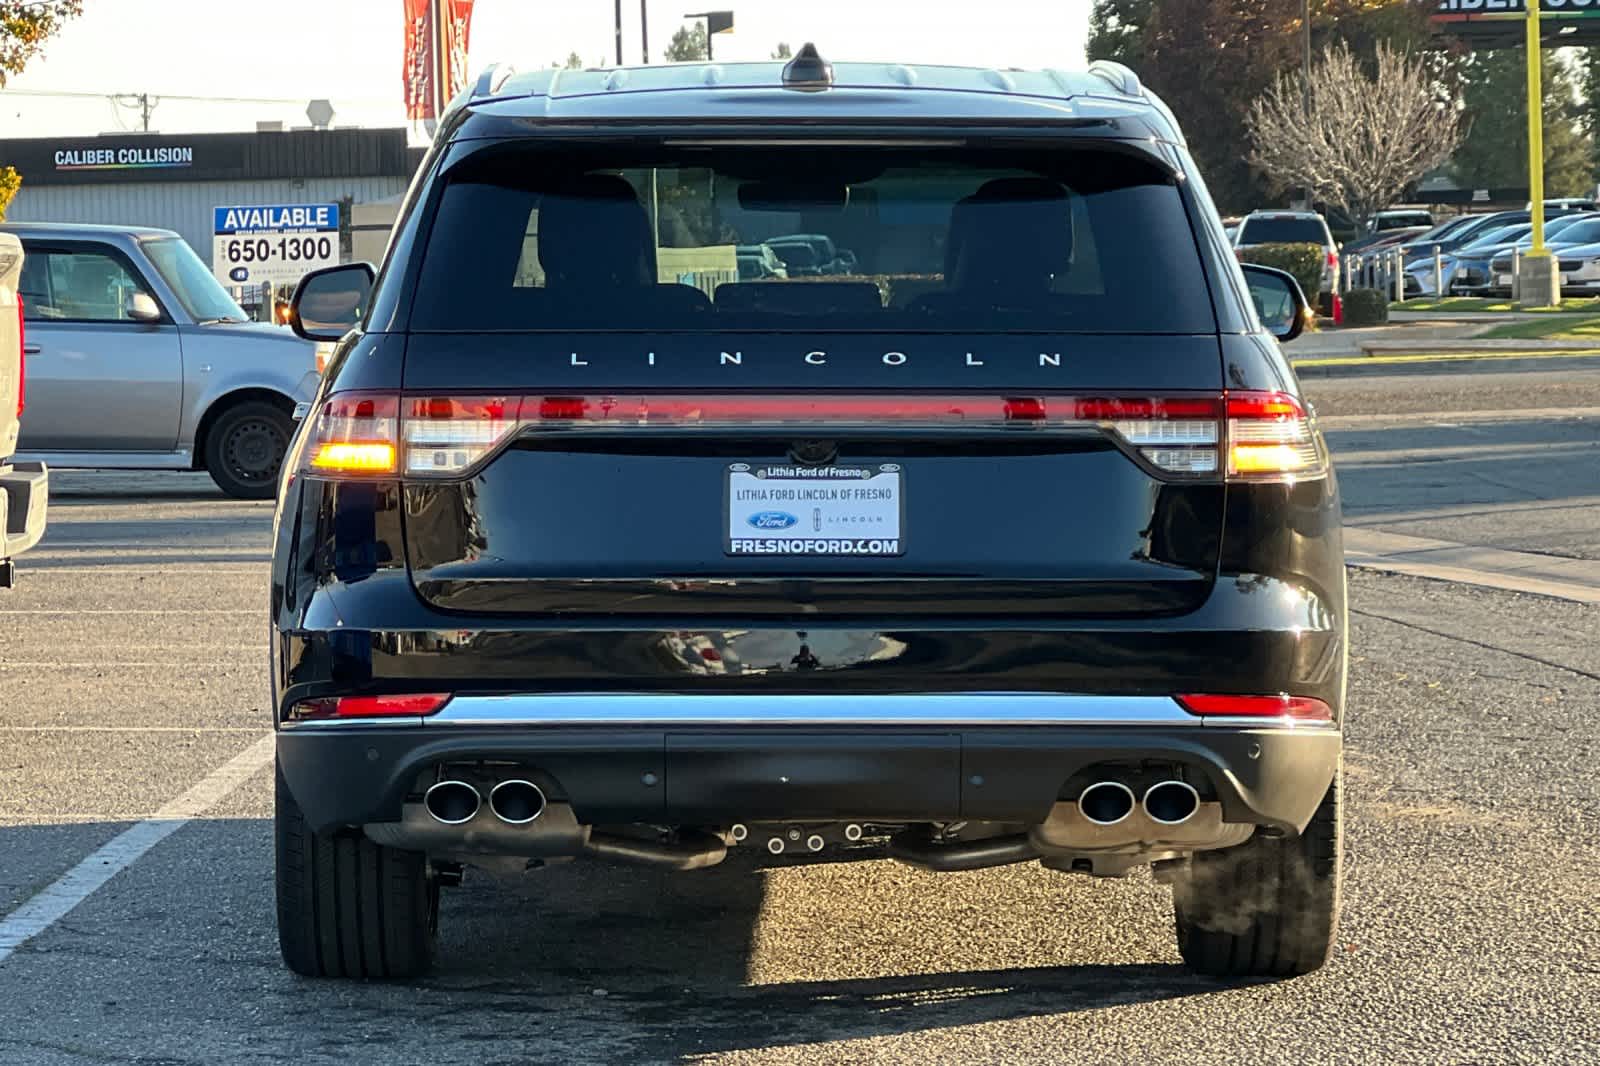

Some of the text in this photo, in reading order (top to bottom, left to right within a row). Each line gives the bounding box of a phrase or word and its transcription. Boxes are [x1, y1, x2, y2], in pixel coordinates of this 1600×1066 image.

[55, 147, 193, 165] CALIBER COLLISION
[224, 207, 329, 228] AVAILABLE
[228, 237, 331, 263] 650-1300
[571, 351, 1061, 367] LINCOLN
[767, 467, 861, 477] Lithia Ford of Fresno
[736, 487, 892, 501] LITHIA FORD LINCOLN OF FRESNO
[731, 540, 898, 553] FRESNOFORD.COM
